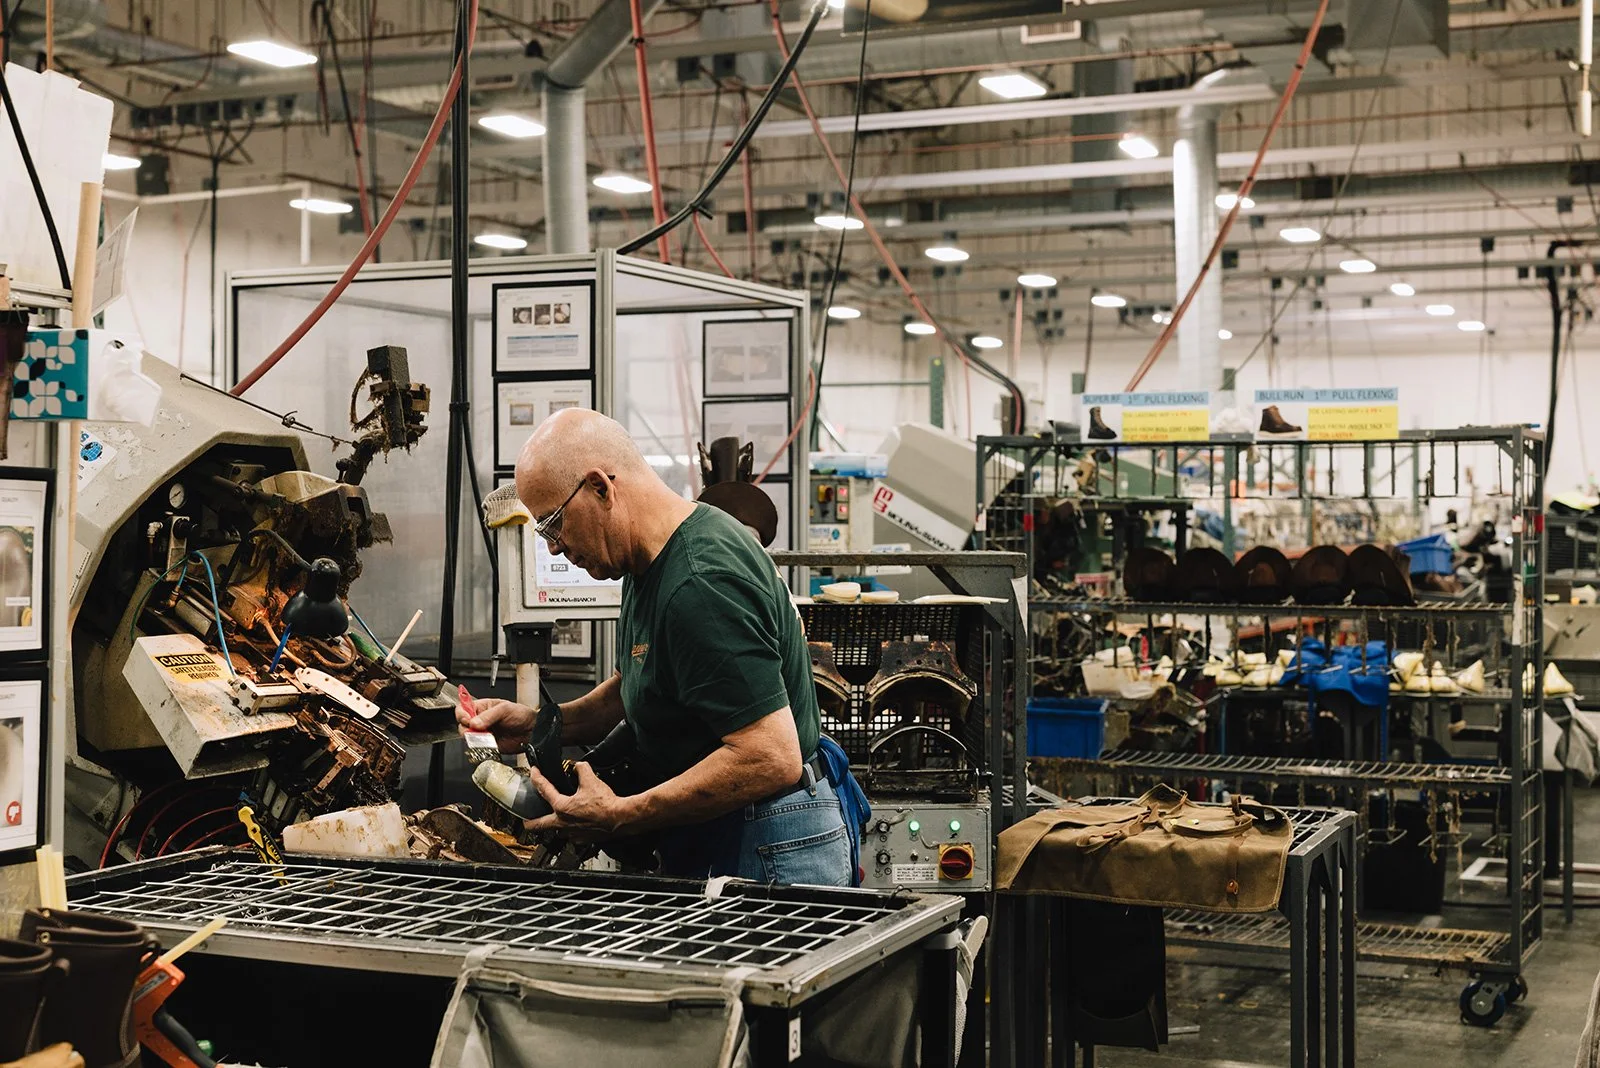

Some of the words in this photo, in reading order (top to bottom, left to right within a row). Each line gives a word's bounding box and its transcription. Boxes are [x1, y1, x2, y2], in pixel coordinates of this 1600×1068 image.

[1144, 395, 1167, 404] PULL
[1168, 394, 1205, 403] FLEXING
[1259, 391, 1282, 400] BULL
[1284, 391, 1304, 400] RUN
[1315, 390, 1327, 400] 1ST
[1332, 390, 1356, 400] PULL
[1358, 389, 1394, 400] FLEXING
[160, 654, 213, 666] CAUTION
[791, 1030, 799, 1053] 3
